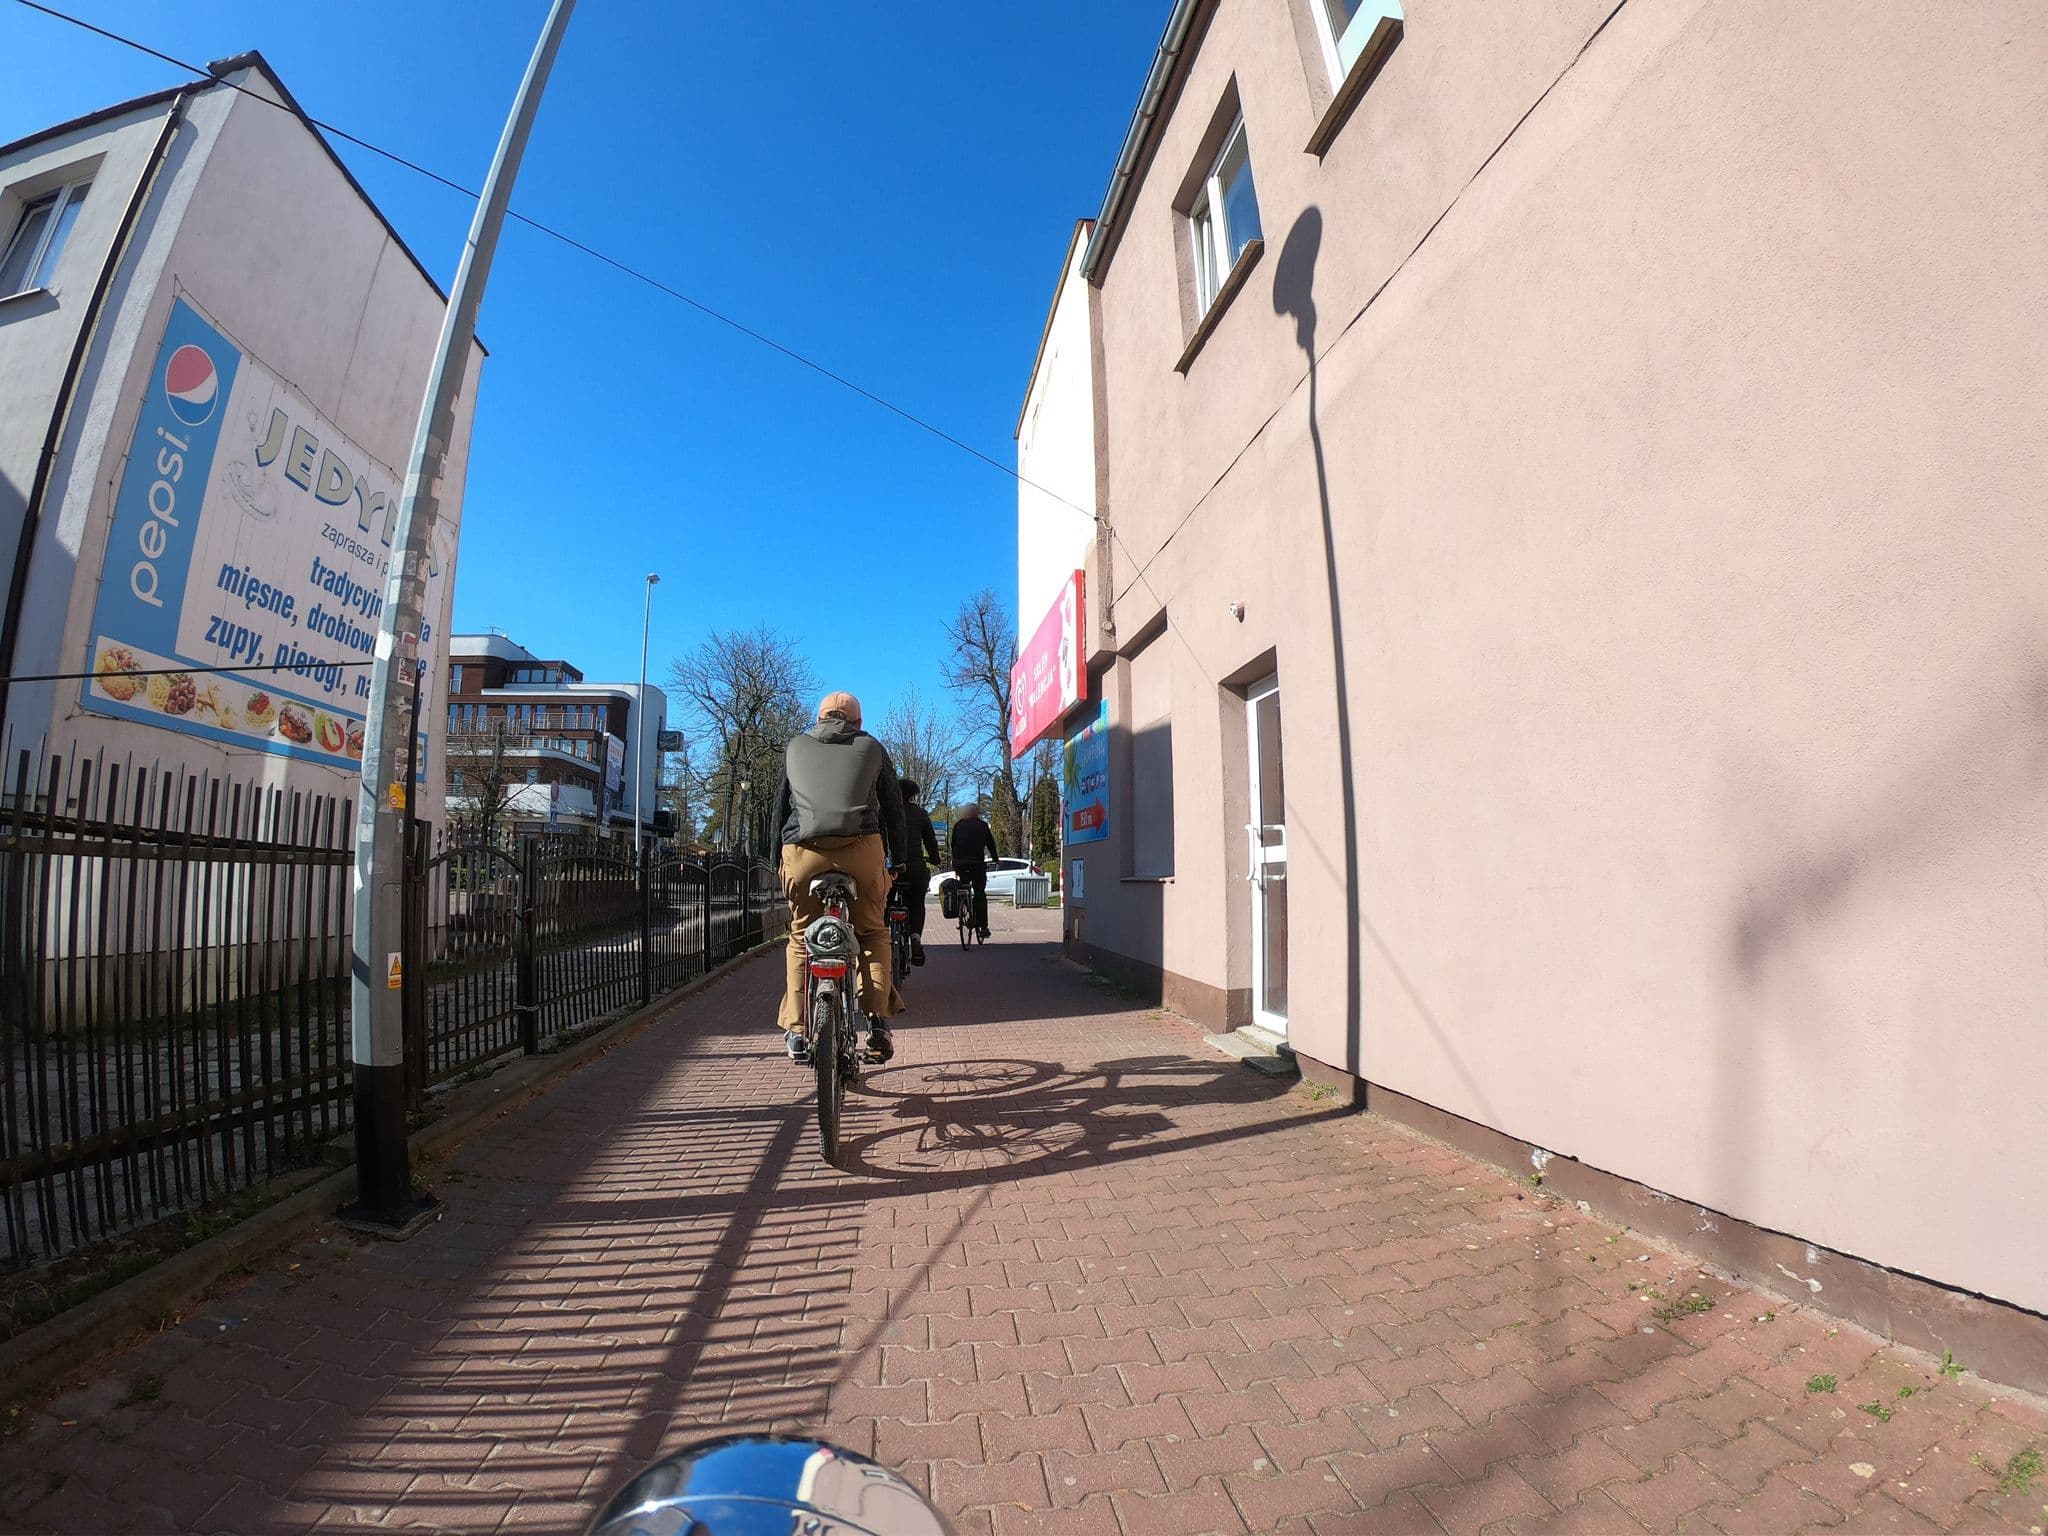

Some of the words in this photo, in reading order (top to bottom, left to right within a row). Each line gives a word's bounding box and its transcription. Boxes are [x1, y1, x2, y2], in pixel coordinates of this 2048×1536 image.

[131, 426, 188, 607] pepsi
[321, 523, 374, 566] zaprasza
[217, 563, 298, 628] mięsne,
[310, 556, 382, 619] tradycyjn
[205, 615, 264, 666] zupy,
[272, 641, 347, 696] pierogi,
